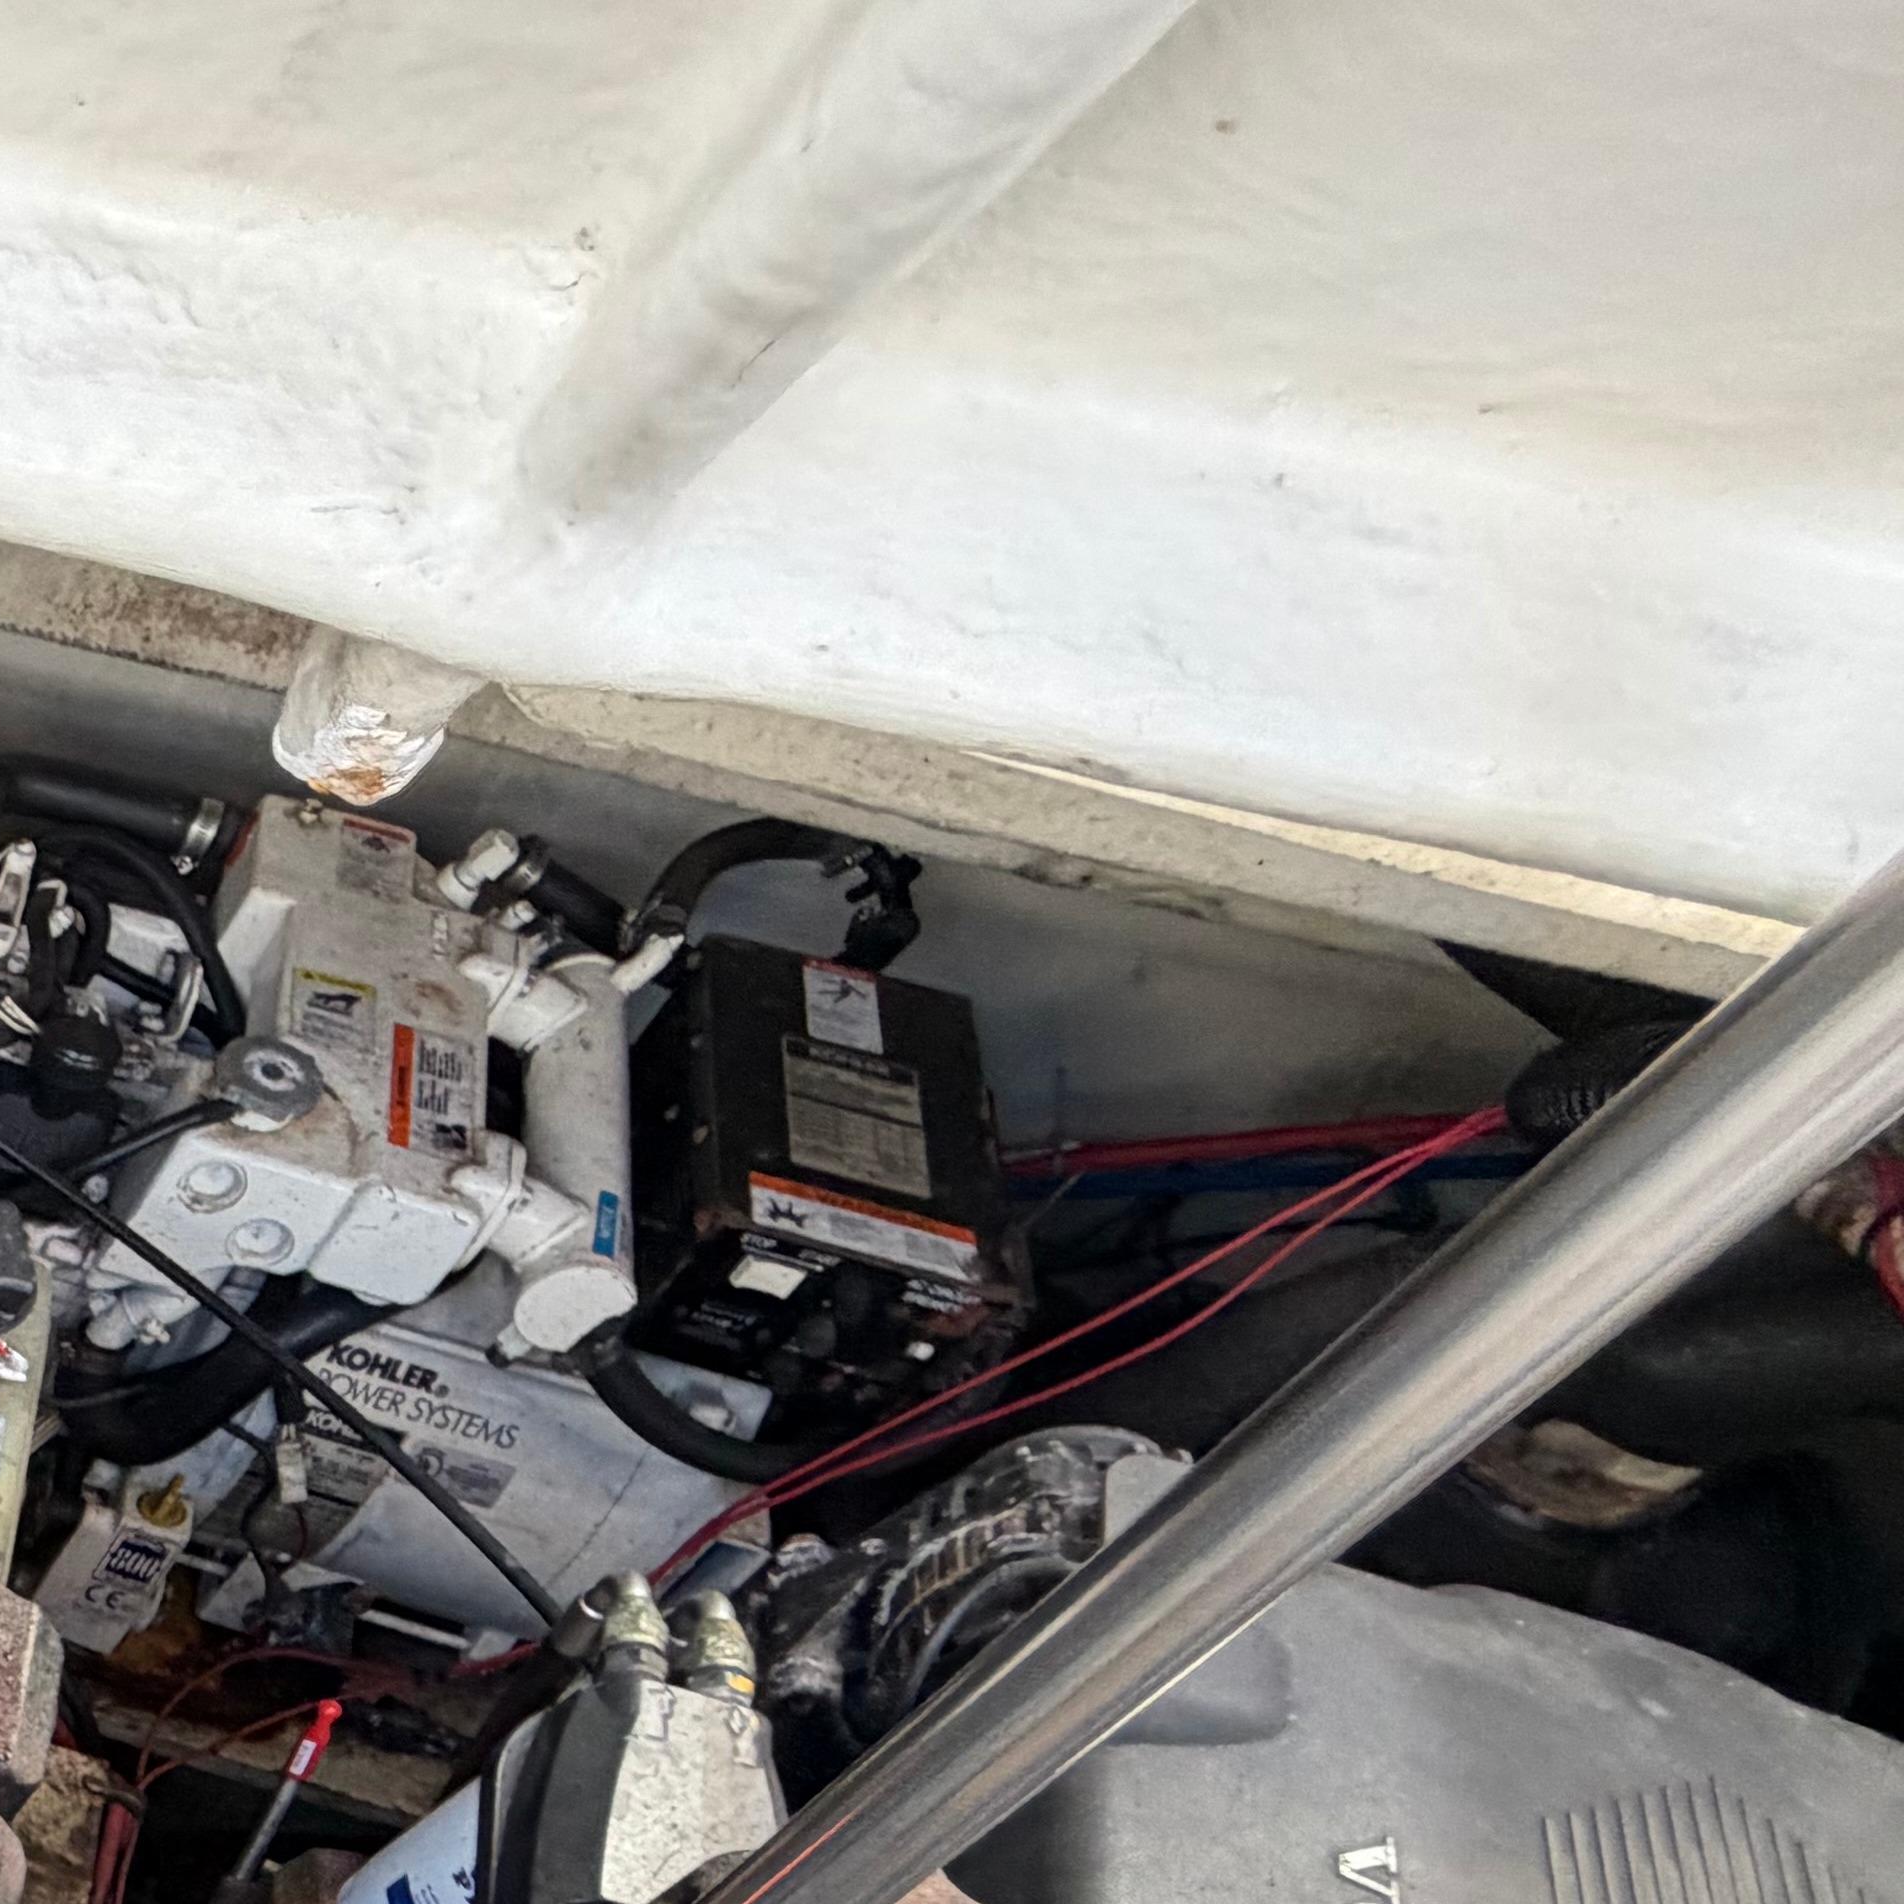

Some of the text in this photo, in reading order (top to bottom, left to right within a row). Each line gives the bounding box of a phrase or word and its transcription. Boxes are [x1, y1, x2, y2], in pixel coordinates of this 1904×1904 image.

[326, 1345, 439, 1393] KOHLER
[317, 1367, 406, 1417] POWER
[407, 1397, 521, 1449] SYSTEMS
